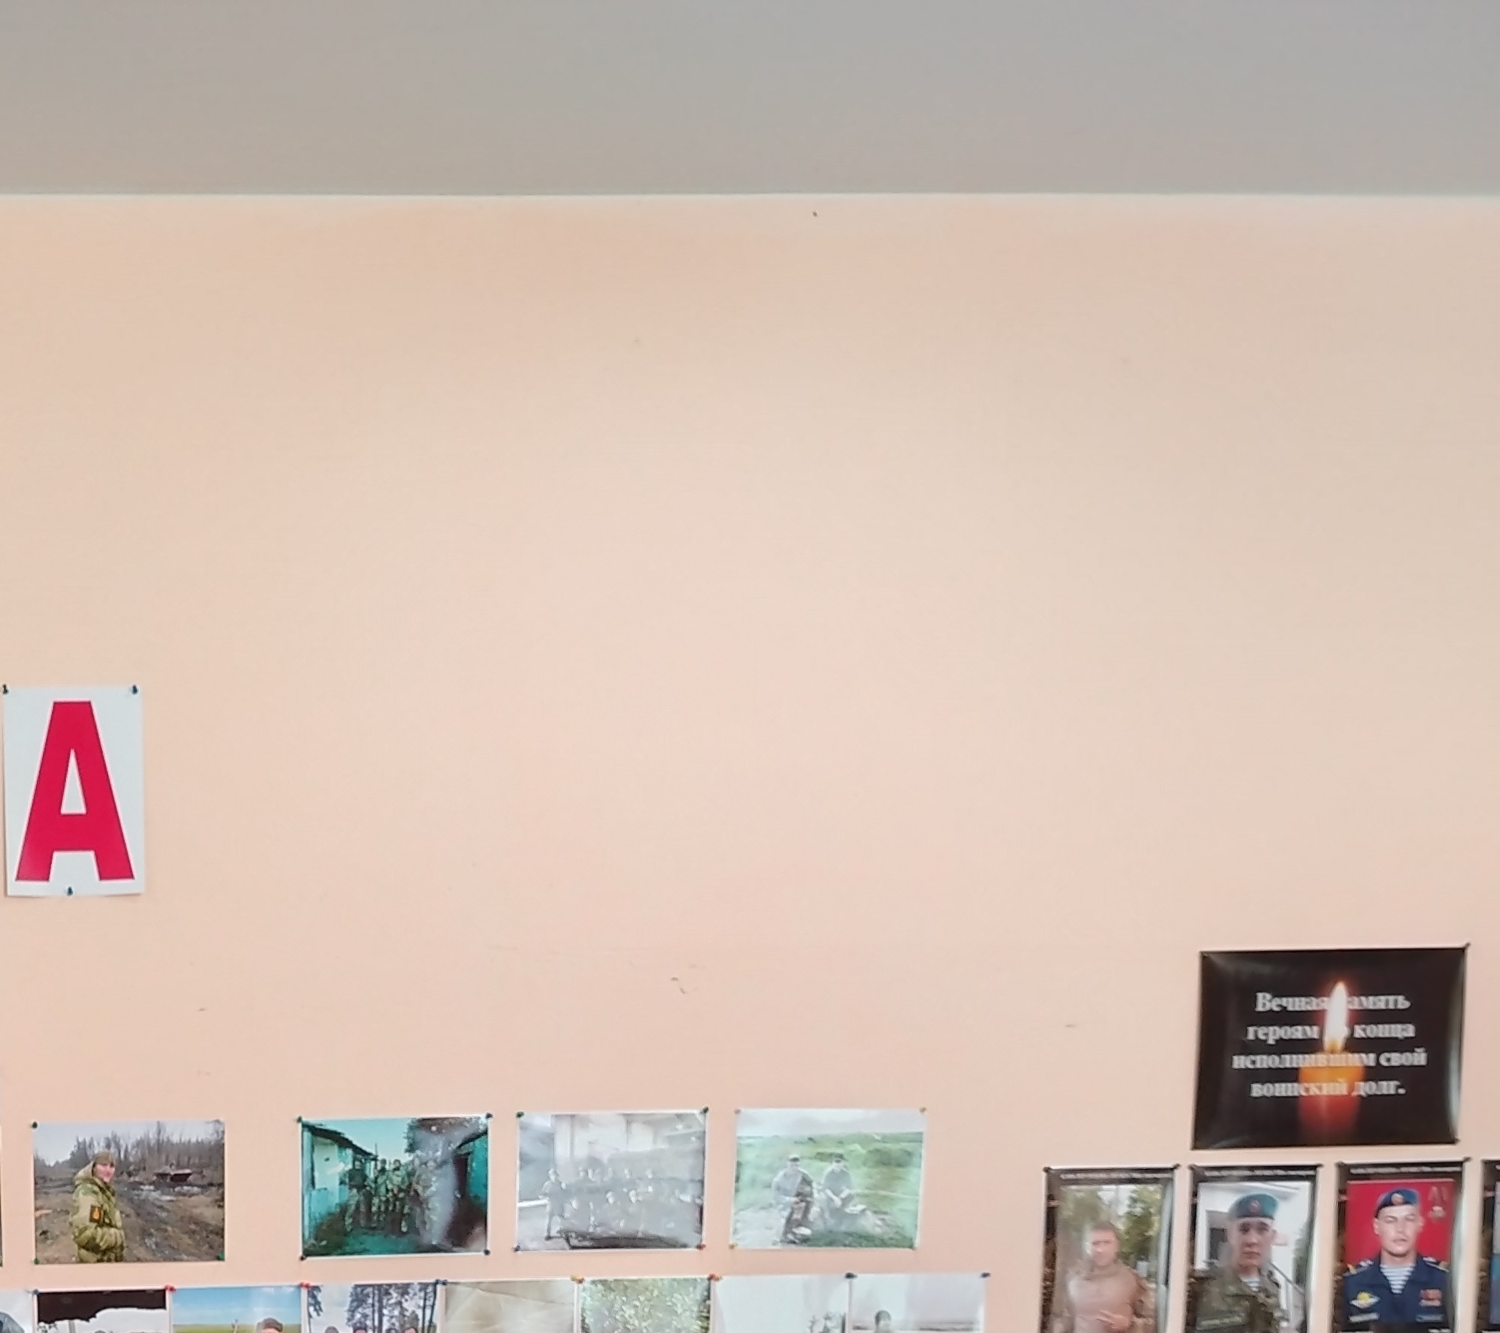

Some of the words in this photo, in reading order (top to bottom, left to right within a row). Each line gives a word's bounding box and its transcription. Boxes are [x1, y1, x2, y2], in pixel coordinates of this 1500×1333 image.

[1255, 992, 1328, 1012] Вечная
[1346, 995, 1411, 1010] амять
[1247, 1025, 1319, 1045] героям
[1353, 1023, 1416, 1040] конца
[1232, 1052, 1376, 1069] исполнившим
[1379, 1048, 1428, 1067] свой
[1251, 1079, 1348, 1097] воинский
[1352, 1080, 1406, 1097] долг.
